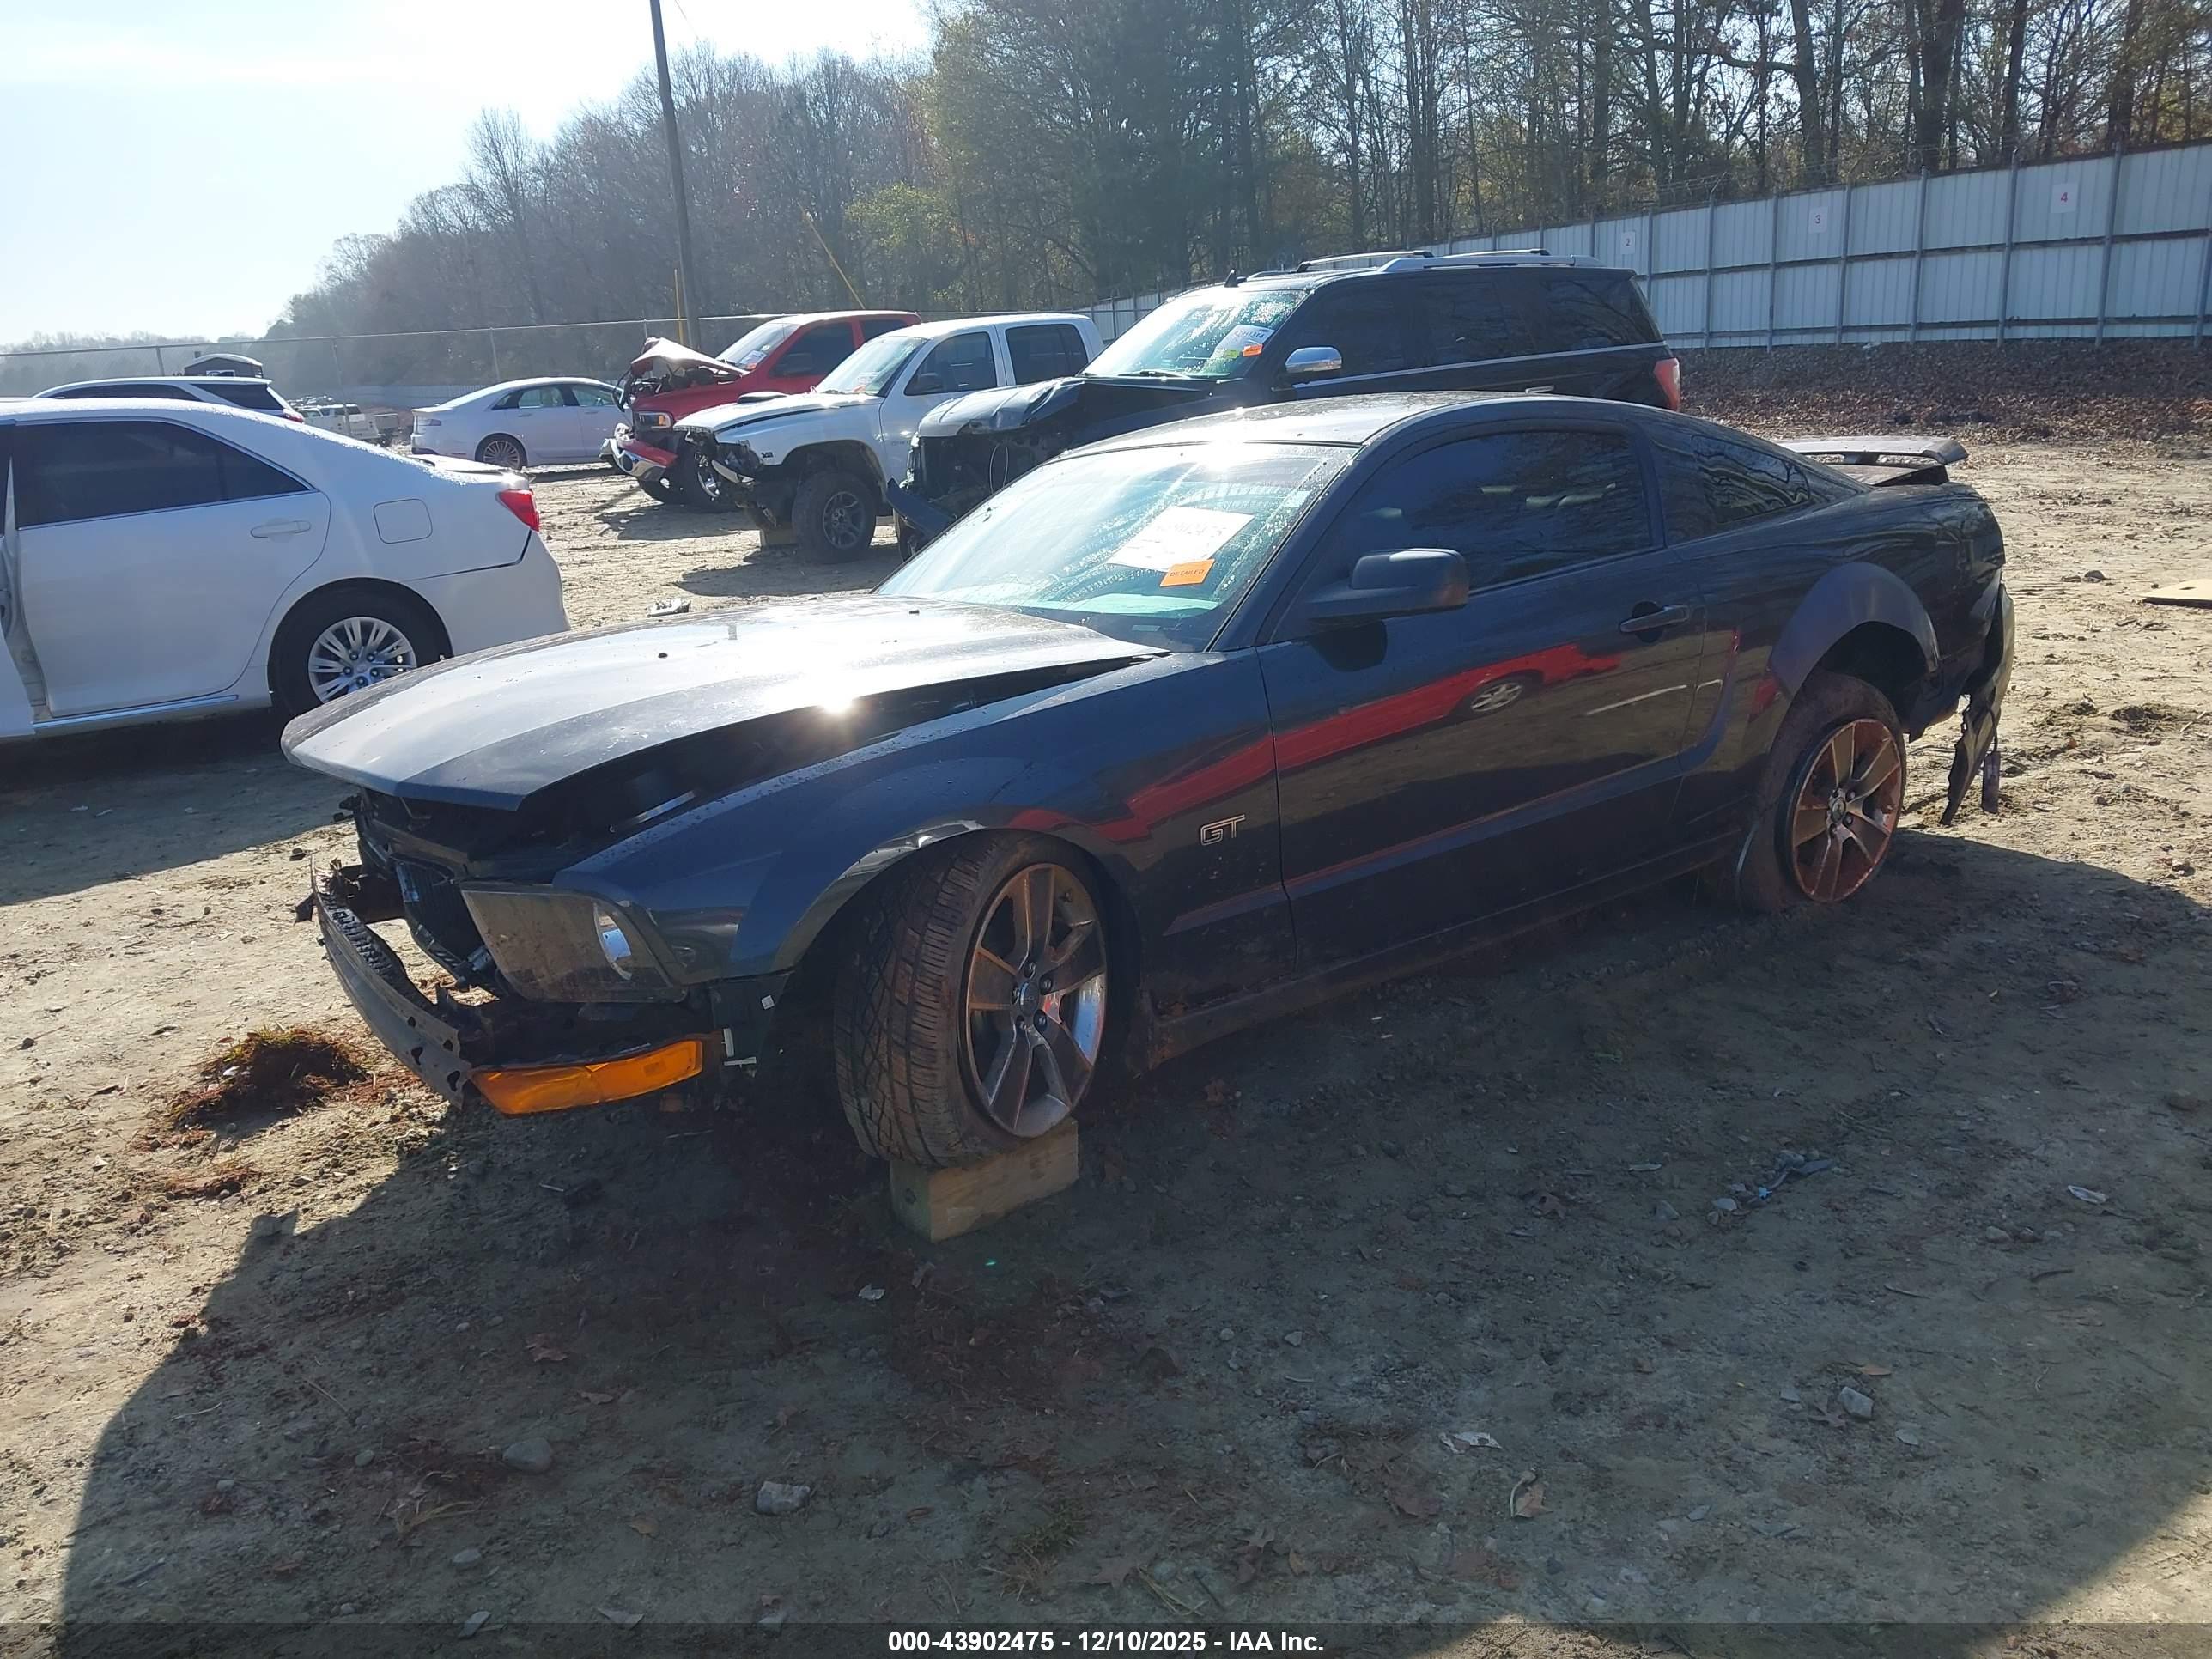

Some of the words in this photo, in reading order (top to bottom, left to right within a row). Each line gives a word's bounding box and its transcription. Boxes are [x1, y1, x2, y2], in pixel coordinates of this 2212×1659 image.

[2060, 191, 2069, 203] 4
[1814, 214, 1821, 224] 3
[1625, 238, 1631, 246] 2
[1200, 813, 1246, 846] GT
